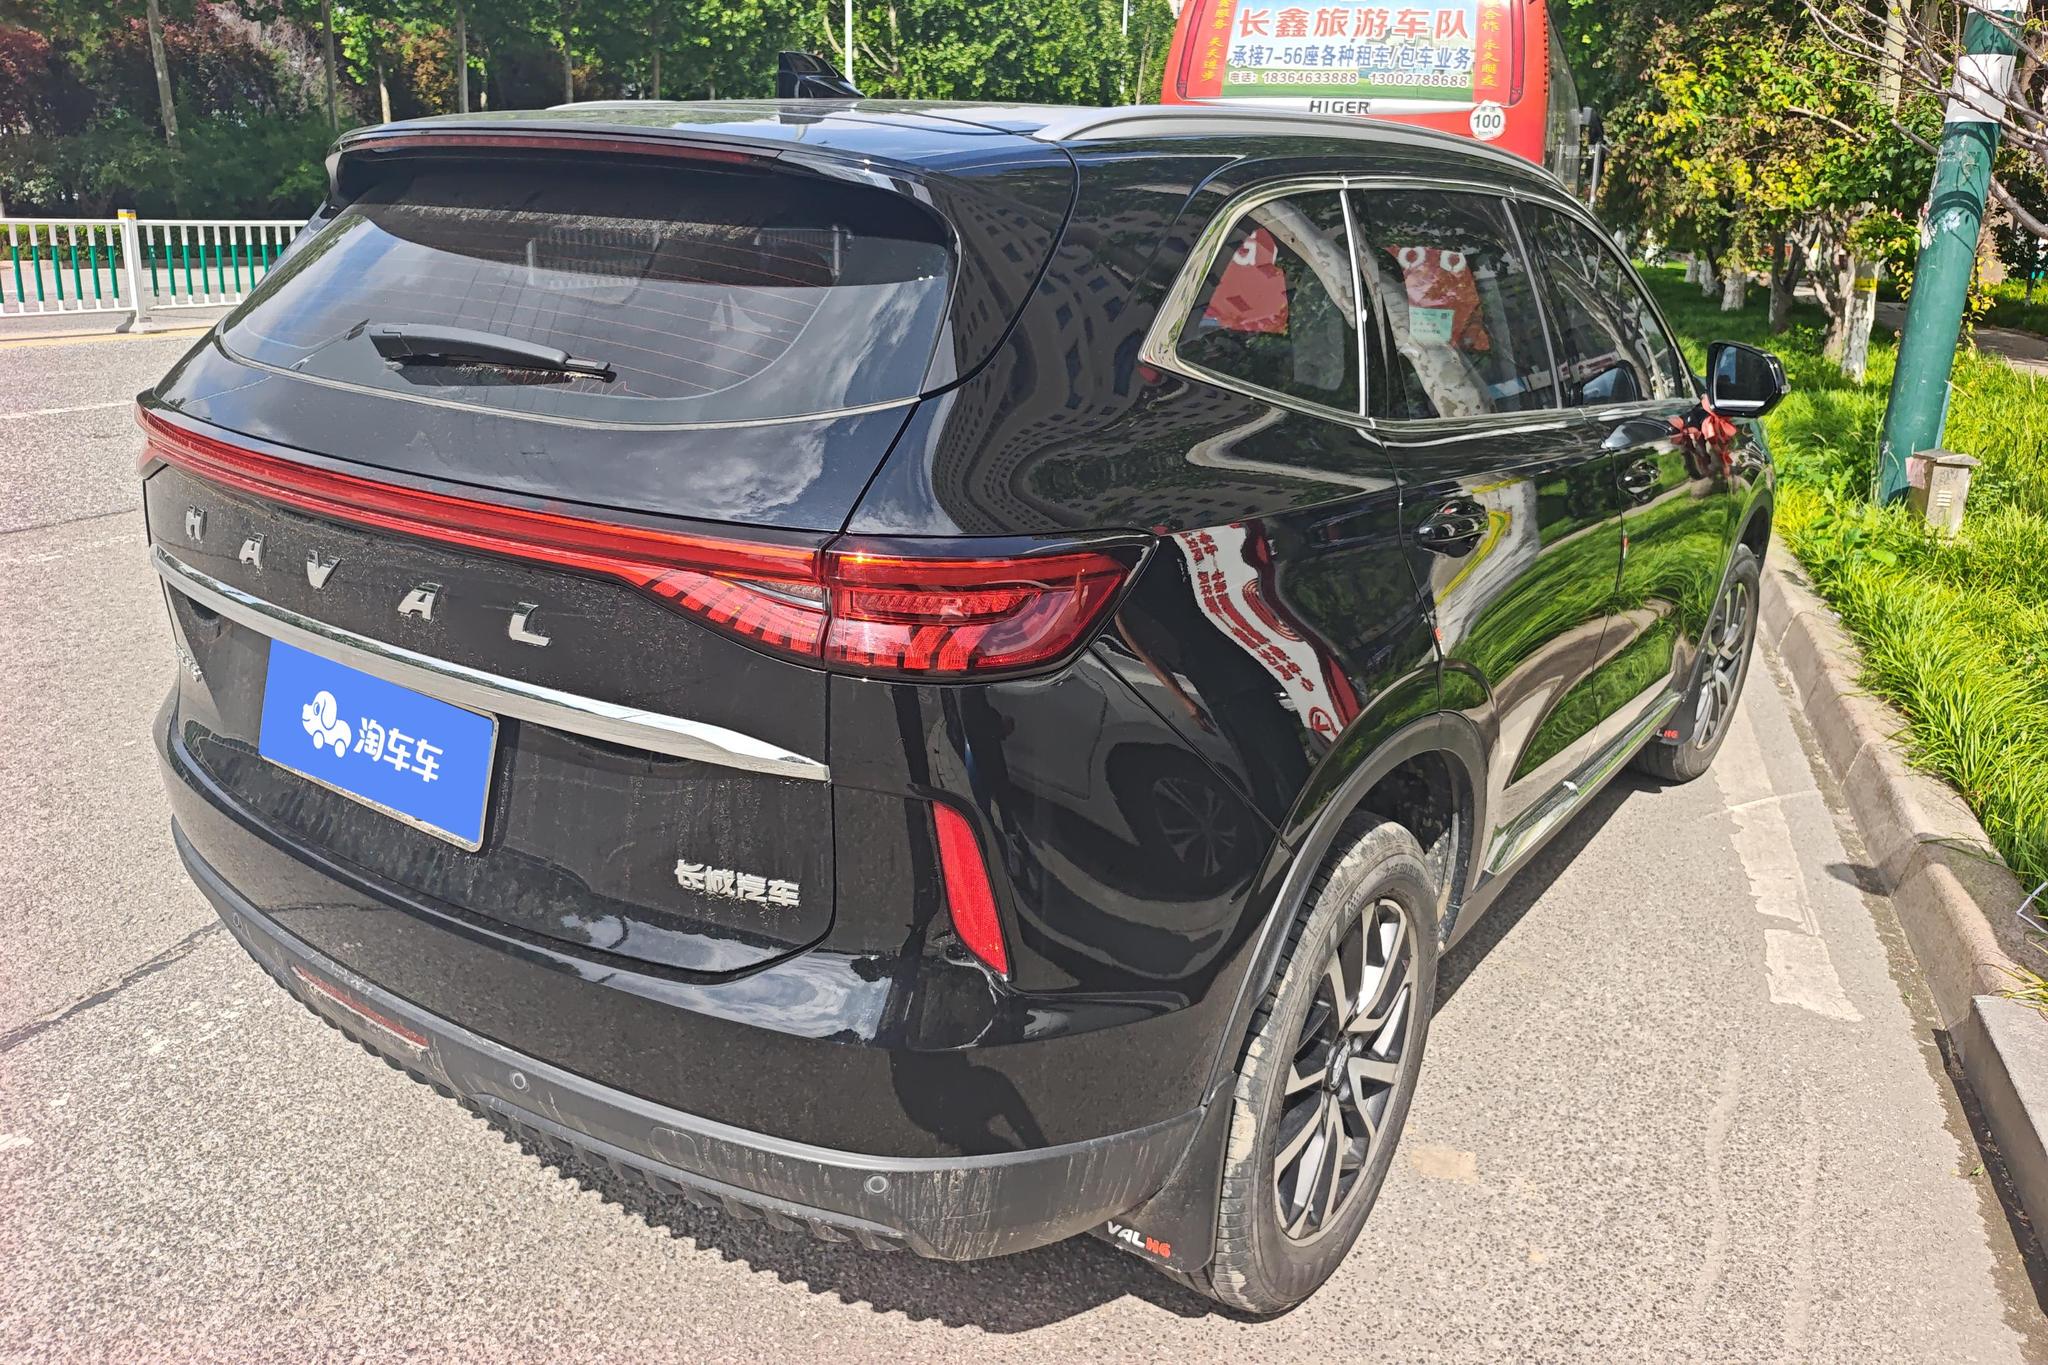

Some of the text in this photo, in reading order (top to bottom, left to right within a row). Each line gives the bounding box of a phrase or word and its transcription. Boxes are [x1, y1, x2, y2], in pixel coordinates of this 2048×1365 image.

[1239, 7, 1469, 39] 长鑫旅游车队
[1231, 44, 1471, 69] 承接7-56座各种租车/包车业务
[1263, 72, 1358, 84] 18364633888
[1370, 73, 1468, 87] 13002788688
[1309, 100, 1370, 115] HIGER
[1474, 114, 1501, 129] 100
[185, 504, 551, 646] HAVAL
[674, 859, 800, 907] 长城汽车
